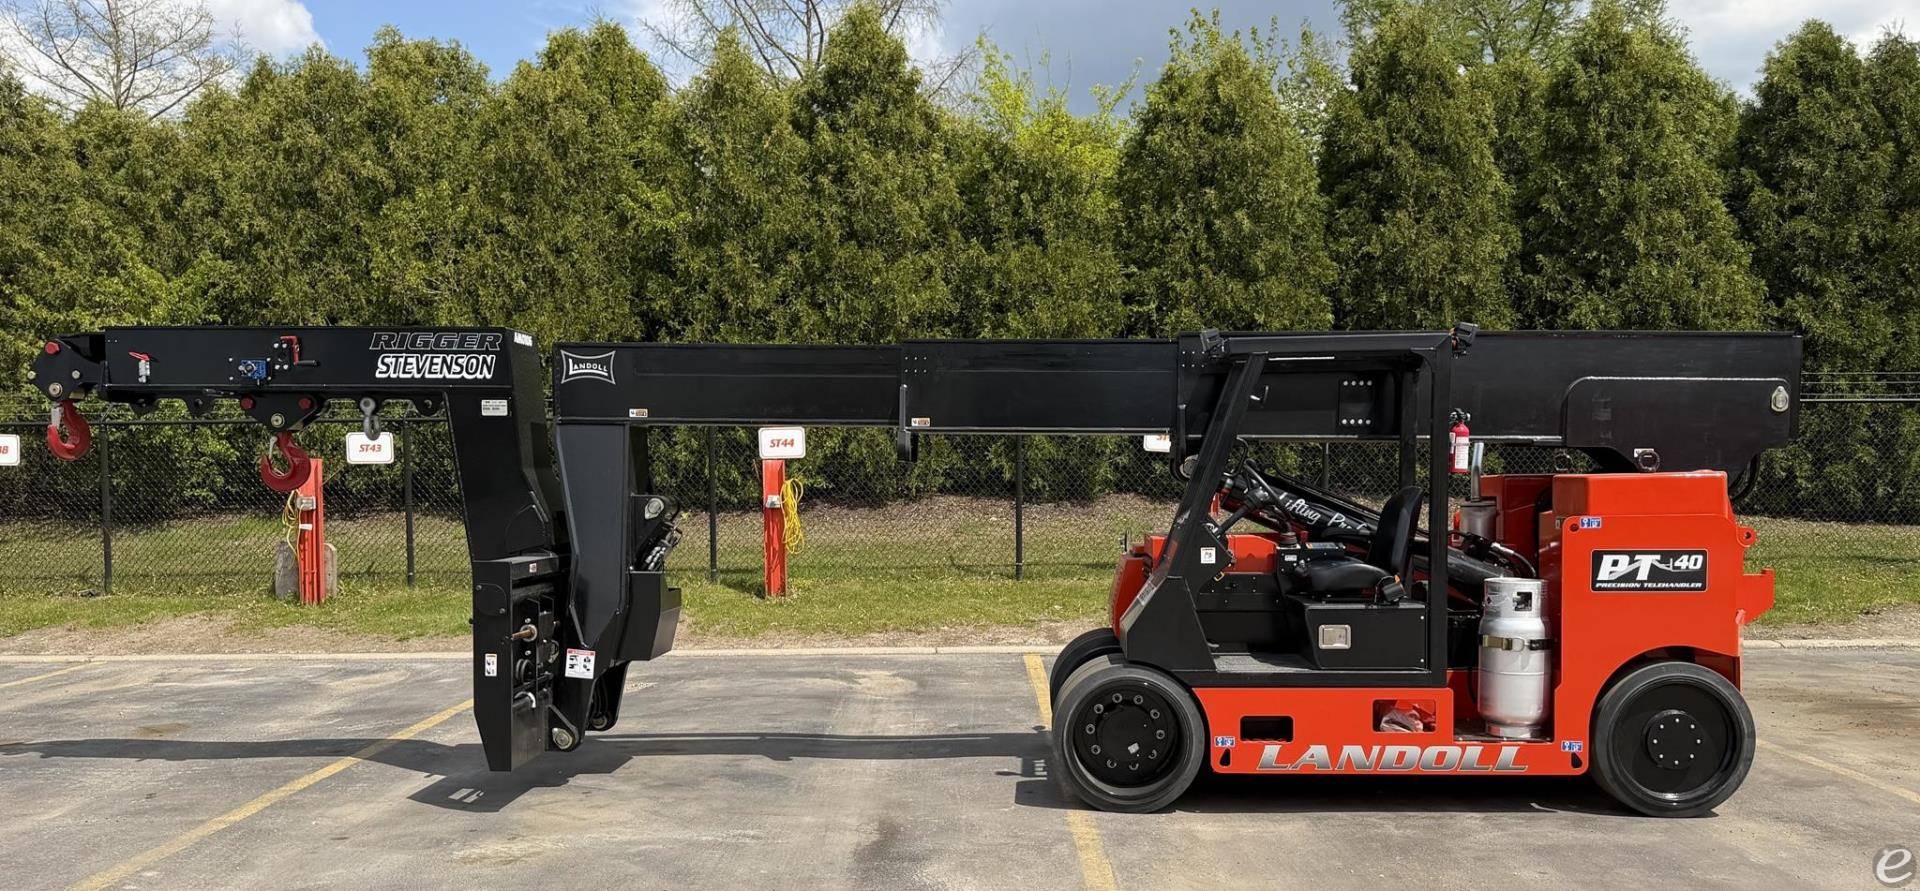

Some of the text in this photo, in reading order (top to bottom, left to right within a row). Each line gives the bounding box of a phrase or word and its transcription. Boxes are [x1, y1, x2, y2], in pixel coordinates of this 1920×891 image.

[369, 332, 503, 350] RIGGER
[375, 353, 496, 379] STEVENSON
[568, 358, 609, 376] LANDOLL
[359, 444, 382, 453] ST43
[770, 438, 795, 448] ST44
[1674, 554, 1703, 570] 40
[1257, 745, 1528, 771] LANDOLL
